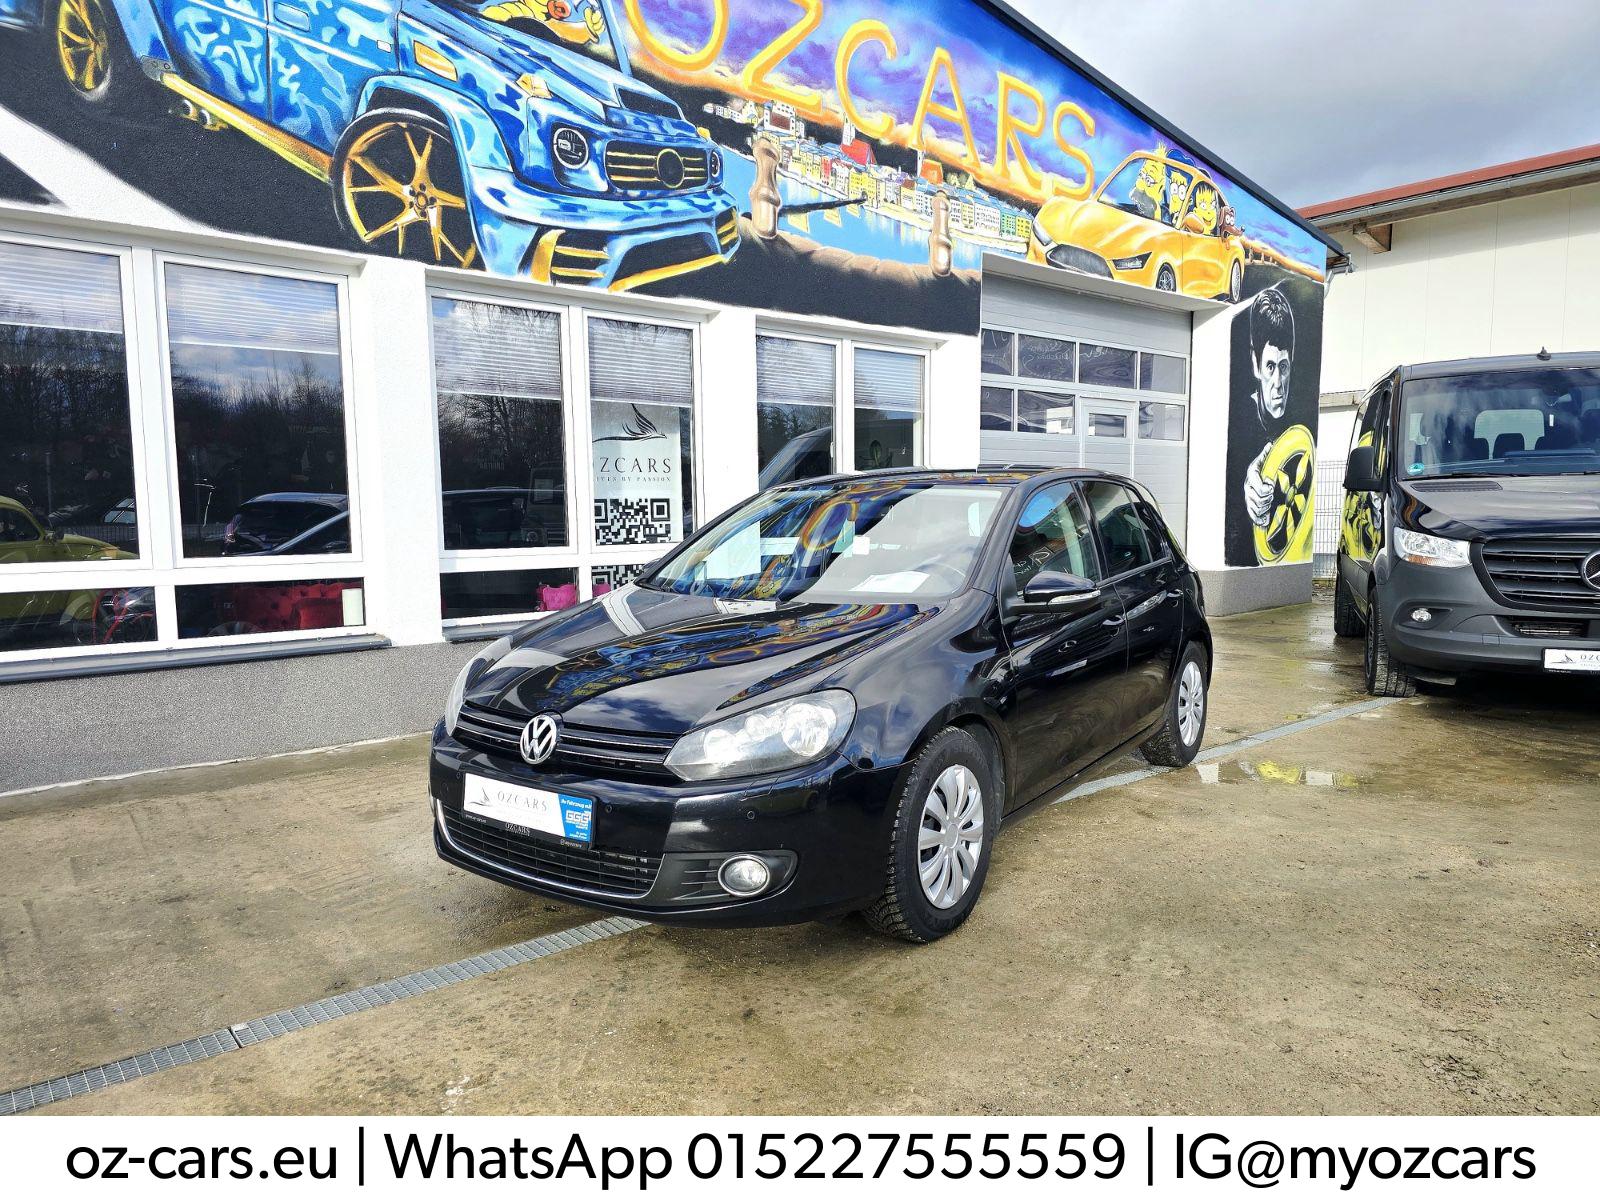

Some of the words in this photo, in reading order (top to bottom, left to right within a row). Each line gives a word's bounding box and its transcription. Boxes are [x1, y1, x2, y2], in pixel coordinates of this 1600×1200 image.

[624, 0, 1097, 200] OZCARS
[593, 457, 671, 473] ZCARS
[497, 790, 548, 811] OZCARS
